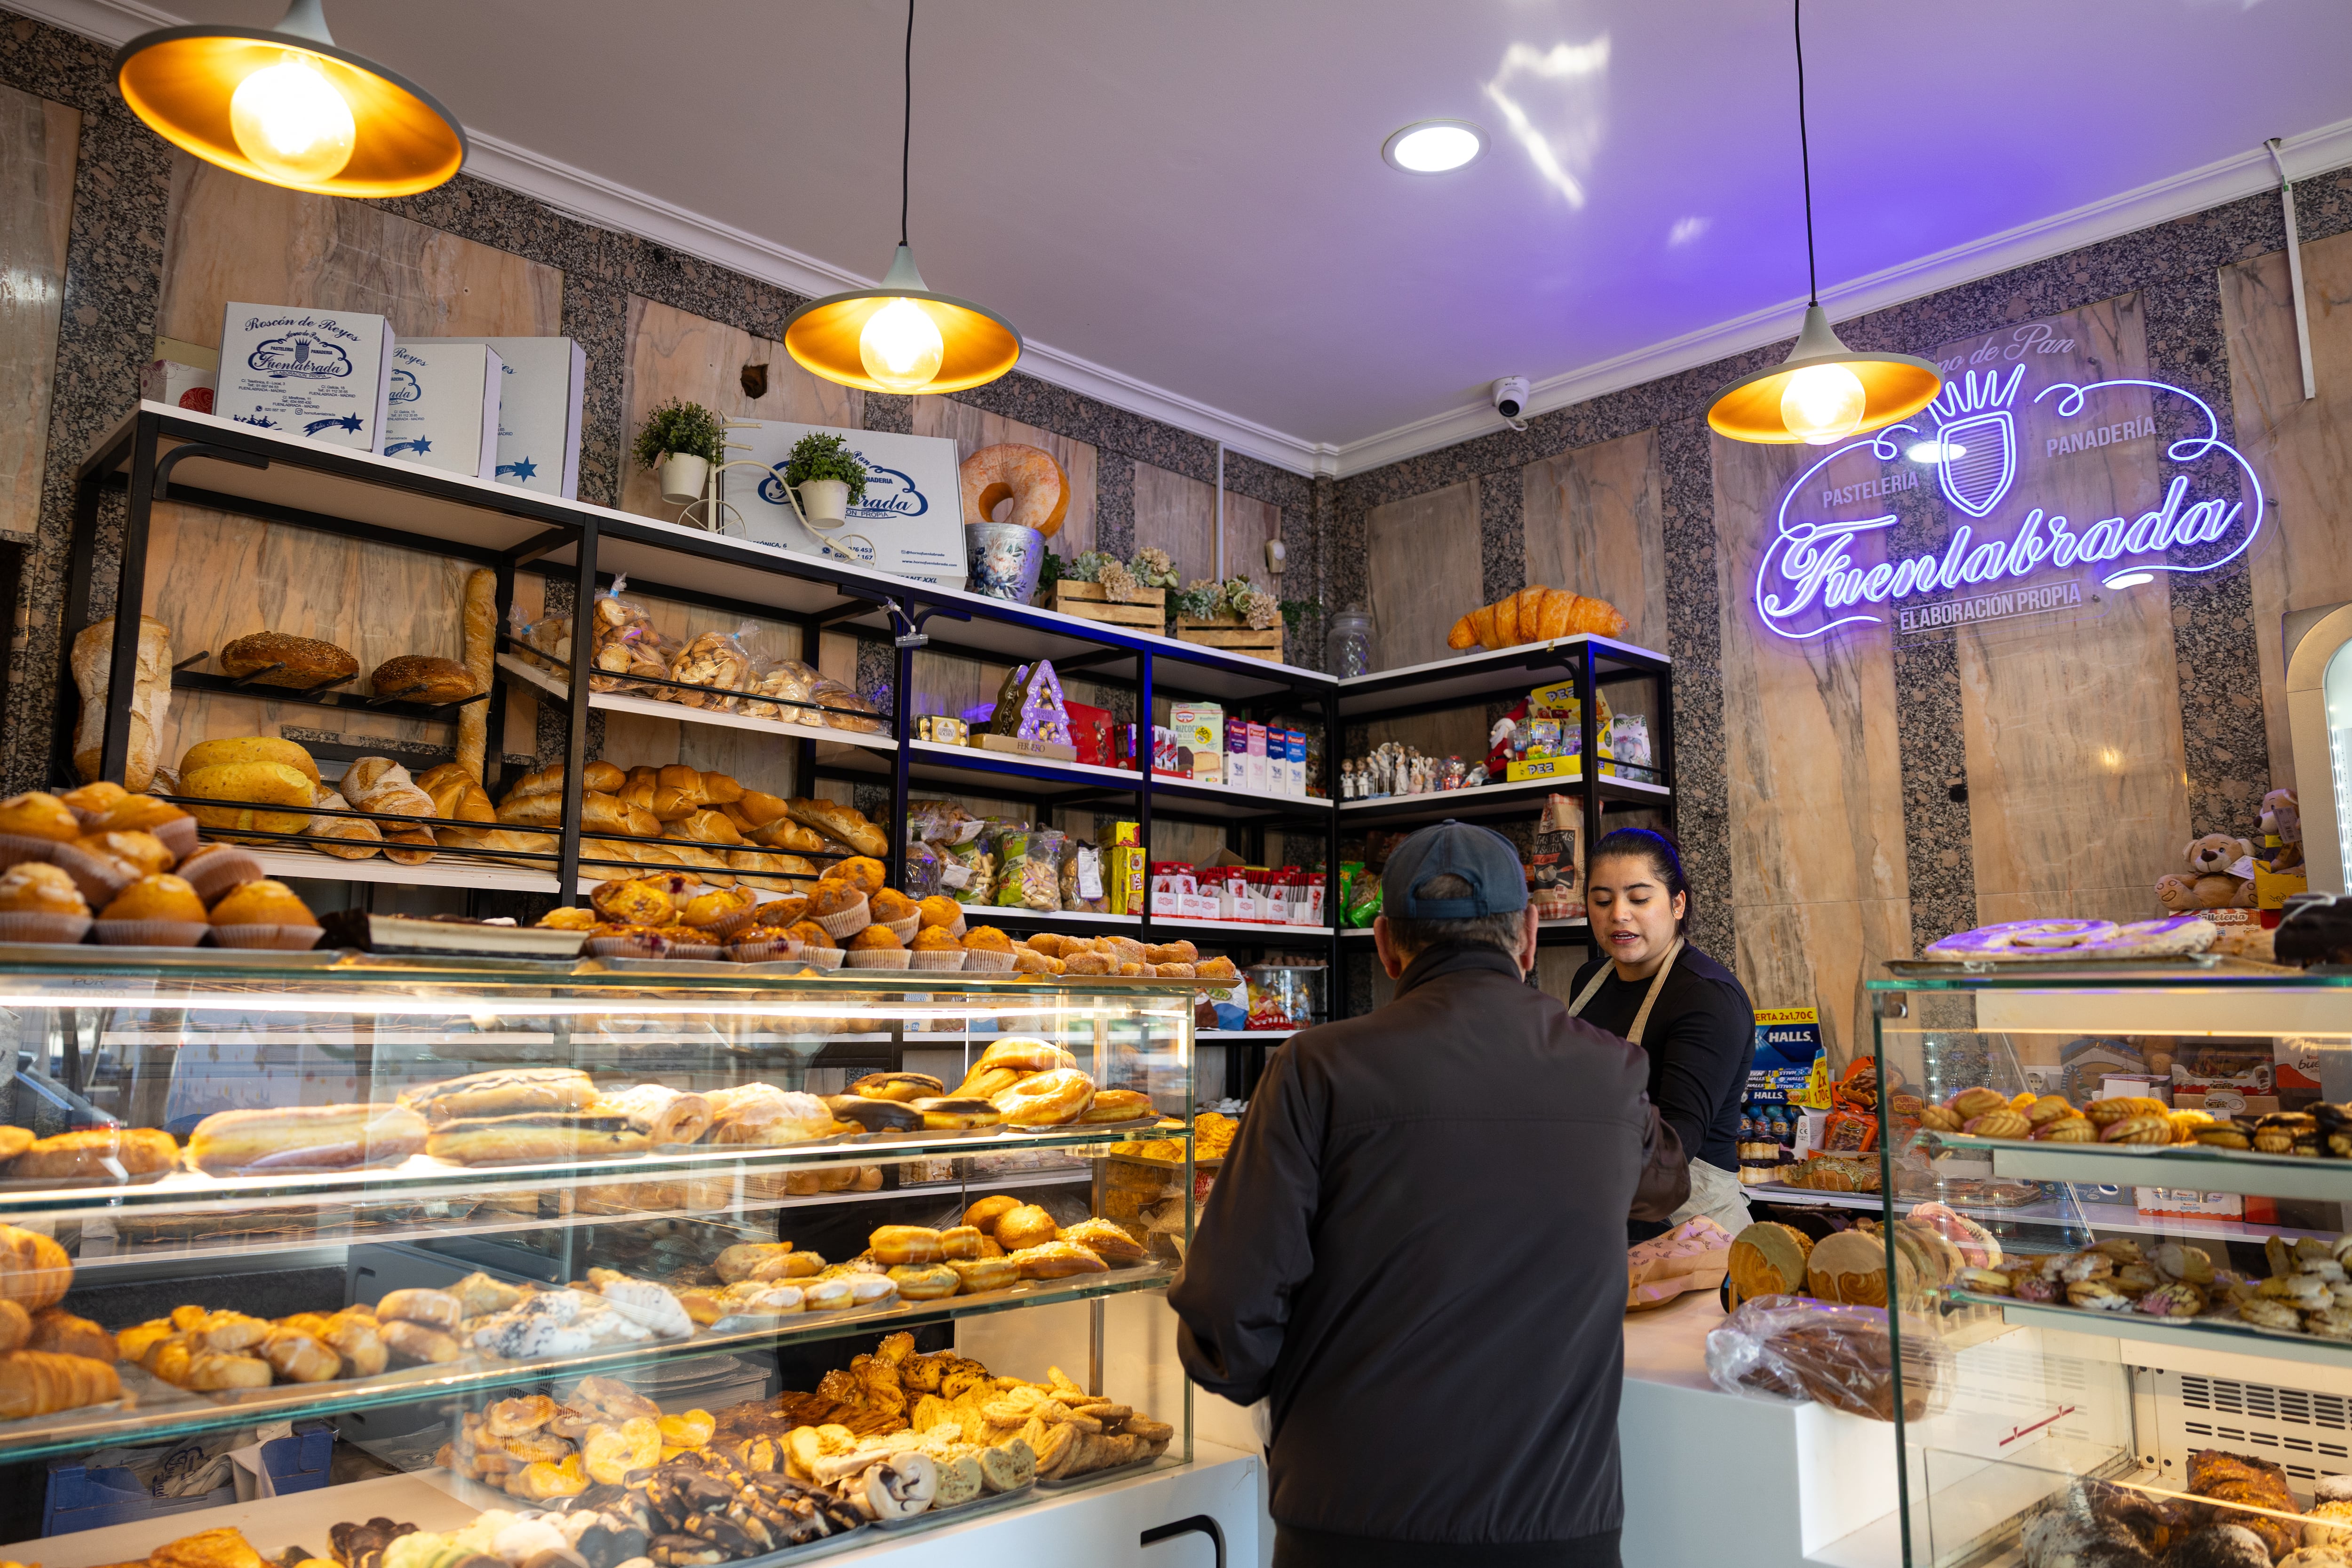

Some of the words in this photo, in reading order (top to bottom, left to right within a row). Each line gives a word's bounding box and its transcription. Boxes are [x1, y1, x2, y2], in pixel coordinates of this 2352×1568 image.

[245, 316, 297, 331] Roscón
[298, 316, 317, 327] de
[318, 319, 361, 341] Reyes
[309, 332, 321, 342] Pan
[1970, 336, 1999, 365] de
[2004, 324, 2075, 360] Pan
[254, 352, 342, 374] Fuenlabrada
[393, 347, 429, 366] Reyes
[2046, 415, 2157, 458] PANADERÍA
[852, 451, 872, 466] Pan
[1823, 470, 1918, 508] PASTELERÍA
[1764, 475, 2243, 619] Fuenlabrada
[1899, 592, 2014, 632] ELABORACIÓN
[2017, 583, 2082, 613] PROPIA
[1546, 687, 1574, 702] PEZ
[1528, 762, 1555, 775] PEZ
[1756, 1012, 1778, 1021] ERTA
[1816, 1061, 1826, 1070] OFERTA
[1817, 1070, 1827, 1088] 2x
